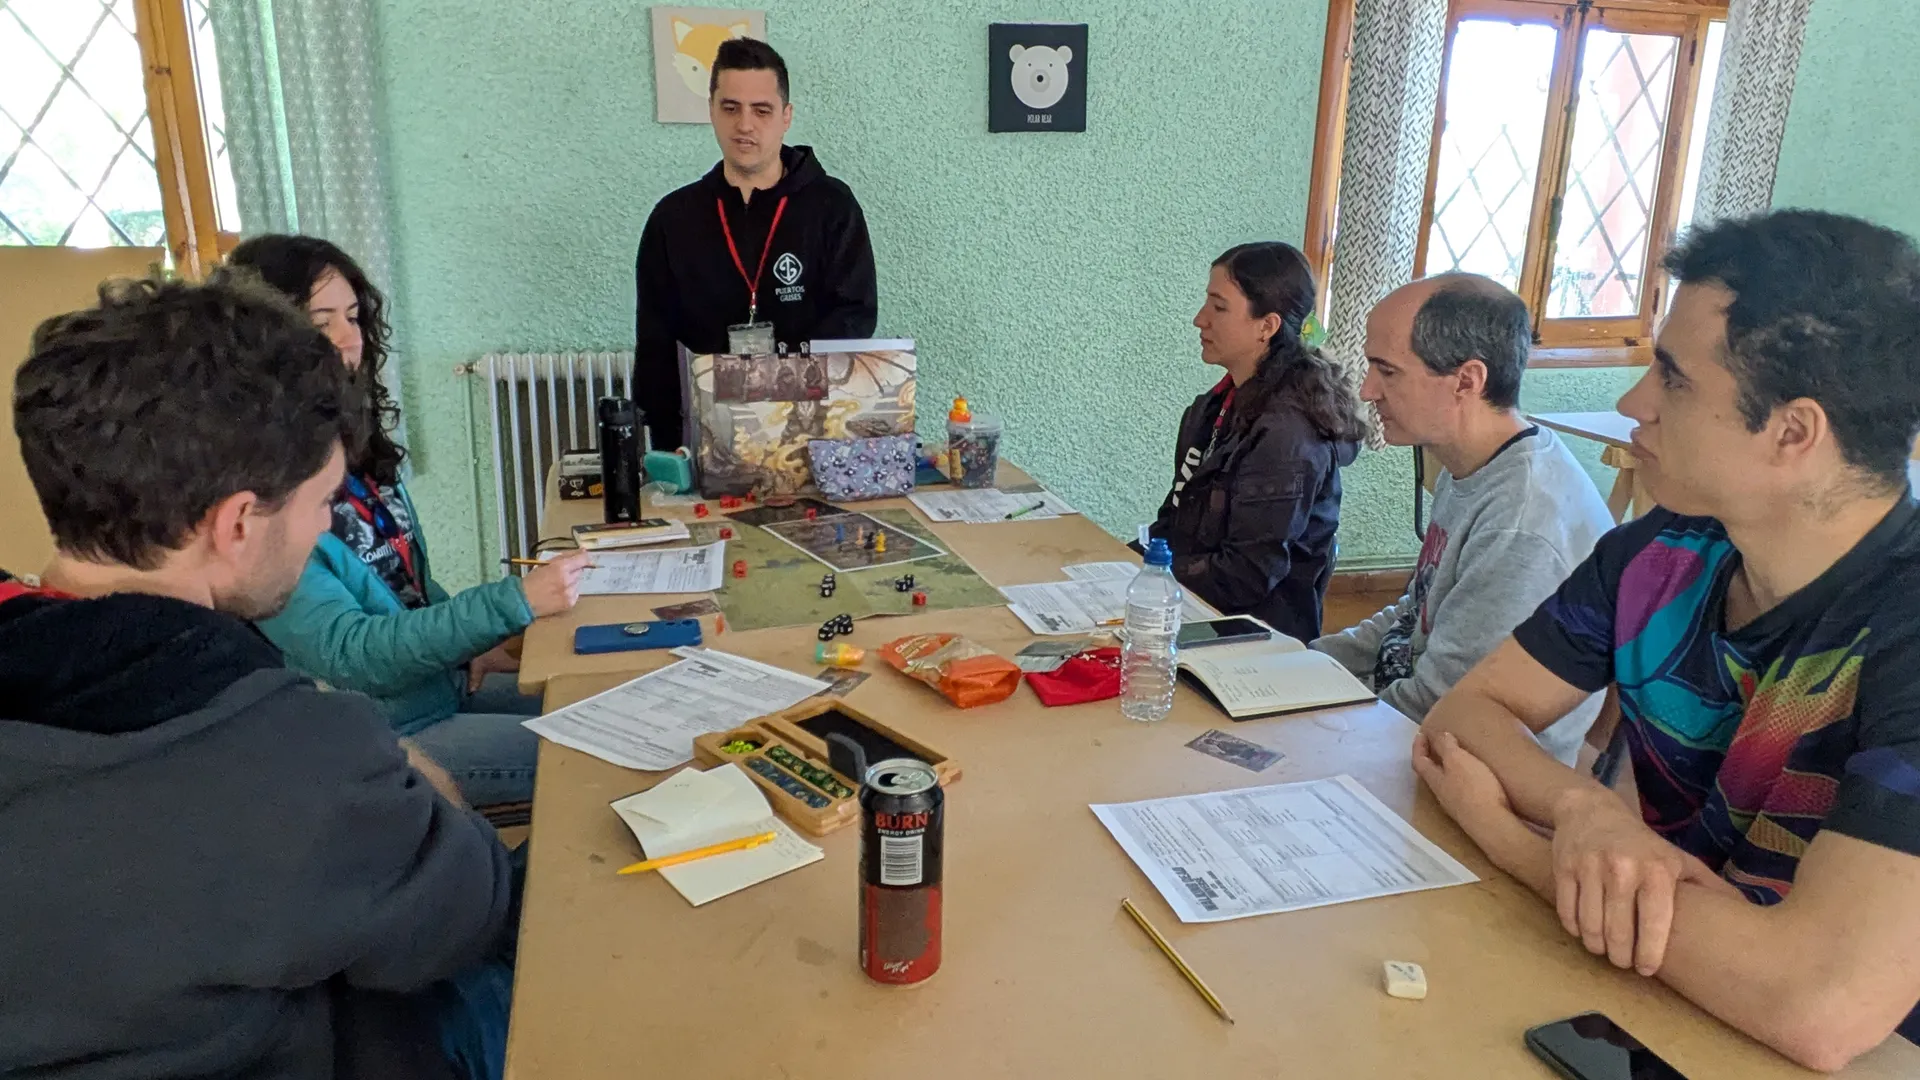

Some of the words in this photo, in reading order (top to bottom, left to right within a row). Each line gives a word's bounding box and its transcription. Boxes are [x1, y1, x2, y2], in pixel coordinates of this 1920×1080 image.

[875, 811, 929, 829] BURN
[877, 828, 903, 836] ENERGY
[905, 827, 926, 836] DRINK
